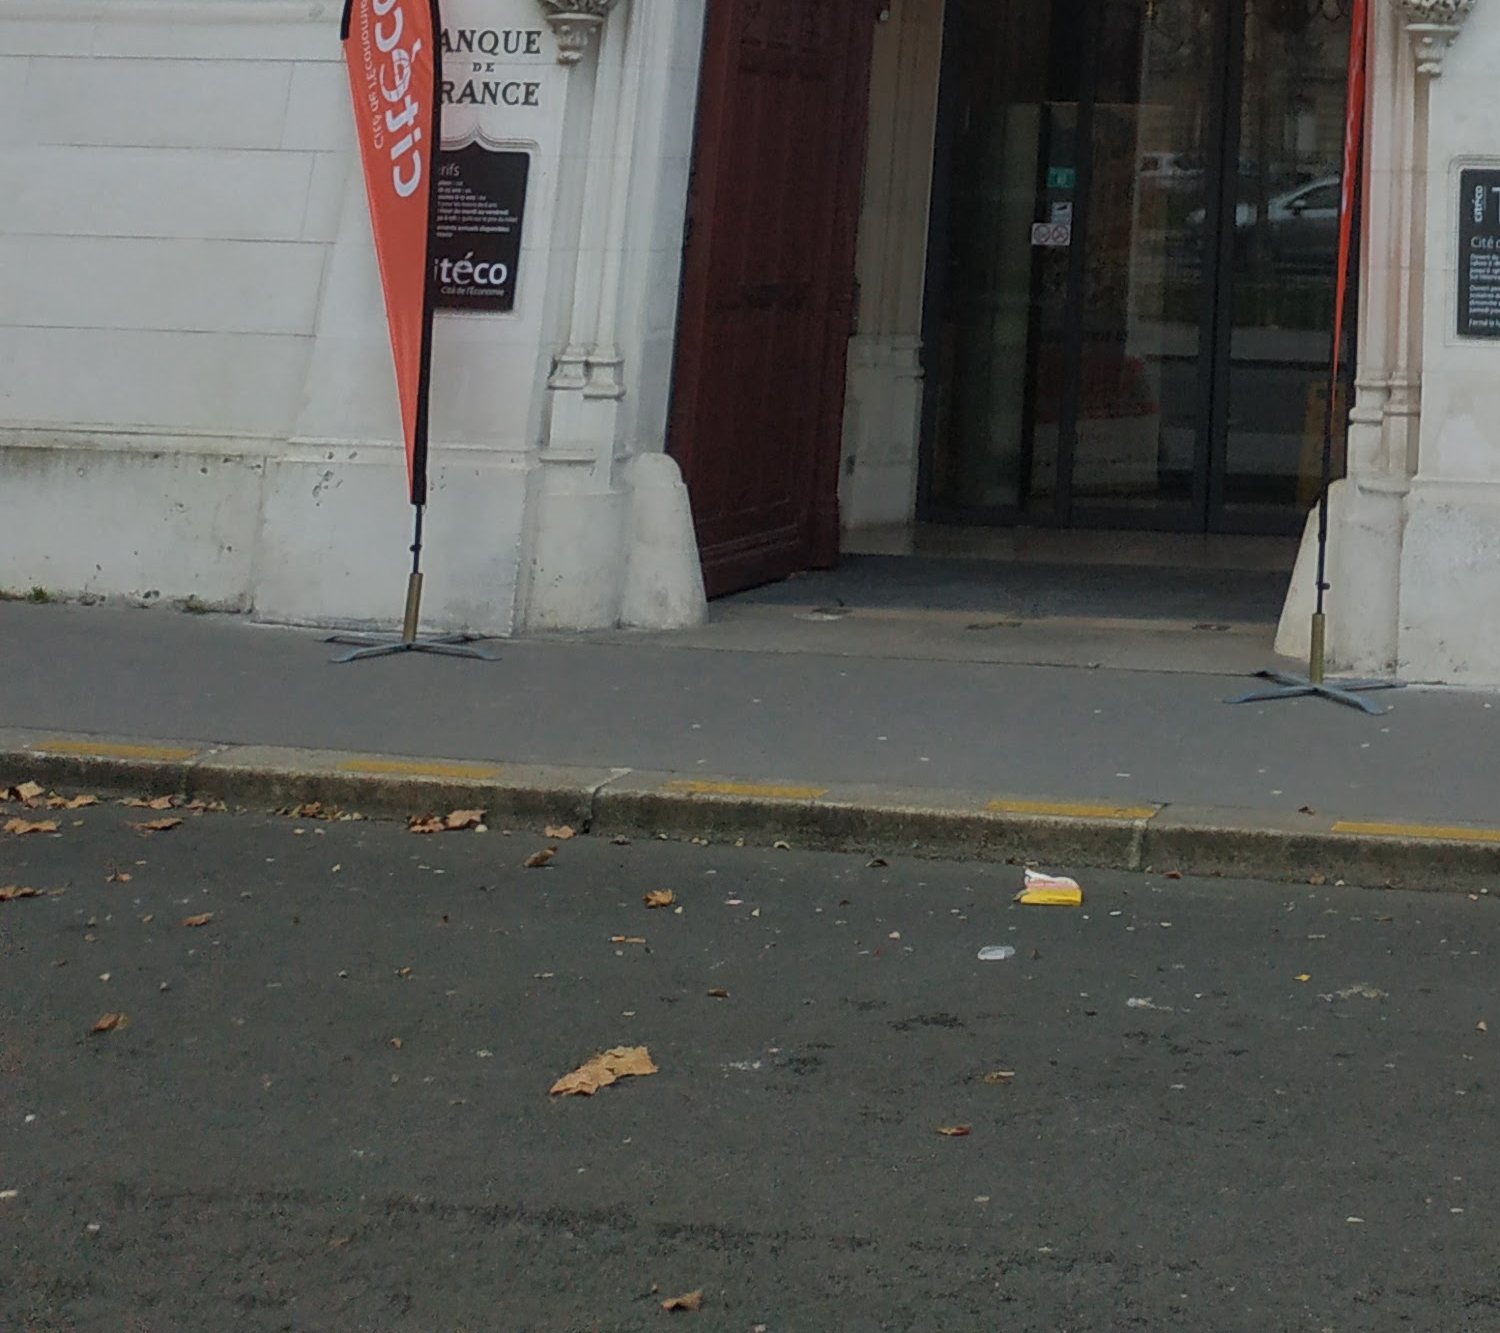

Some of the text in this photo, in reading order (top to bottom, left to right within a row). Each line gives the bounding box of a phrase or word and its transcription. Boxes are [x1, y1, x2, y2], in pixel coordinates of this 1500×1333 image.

[440, 28, 542, 56] ANQUE
[472, 62, 496, 72] DE
[441, 79, 541, 106] RANCE
[441, 162, 460, 176] rifs
[1470, 236, 1494, 249] Cité
[433, 251, 507, 284] itéco
